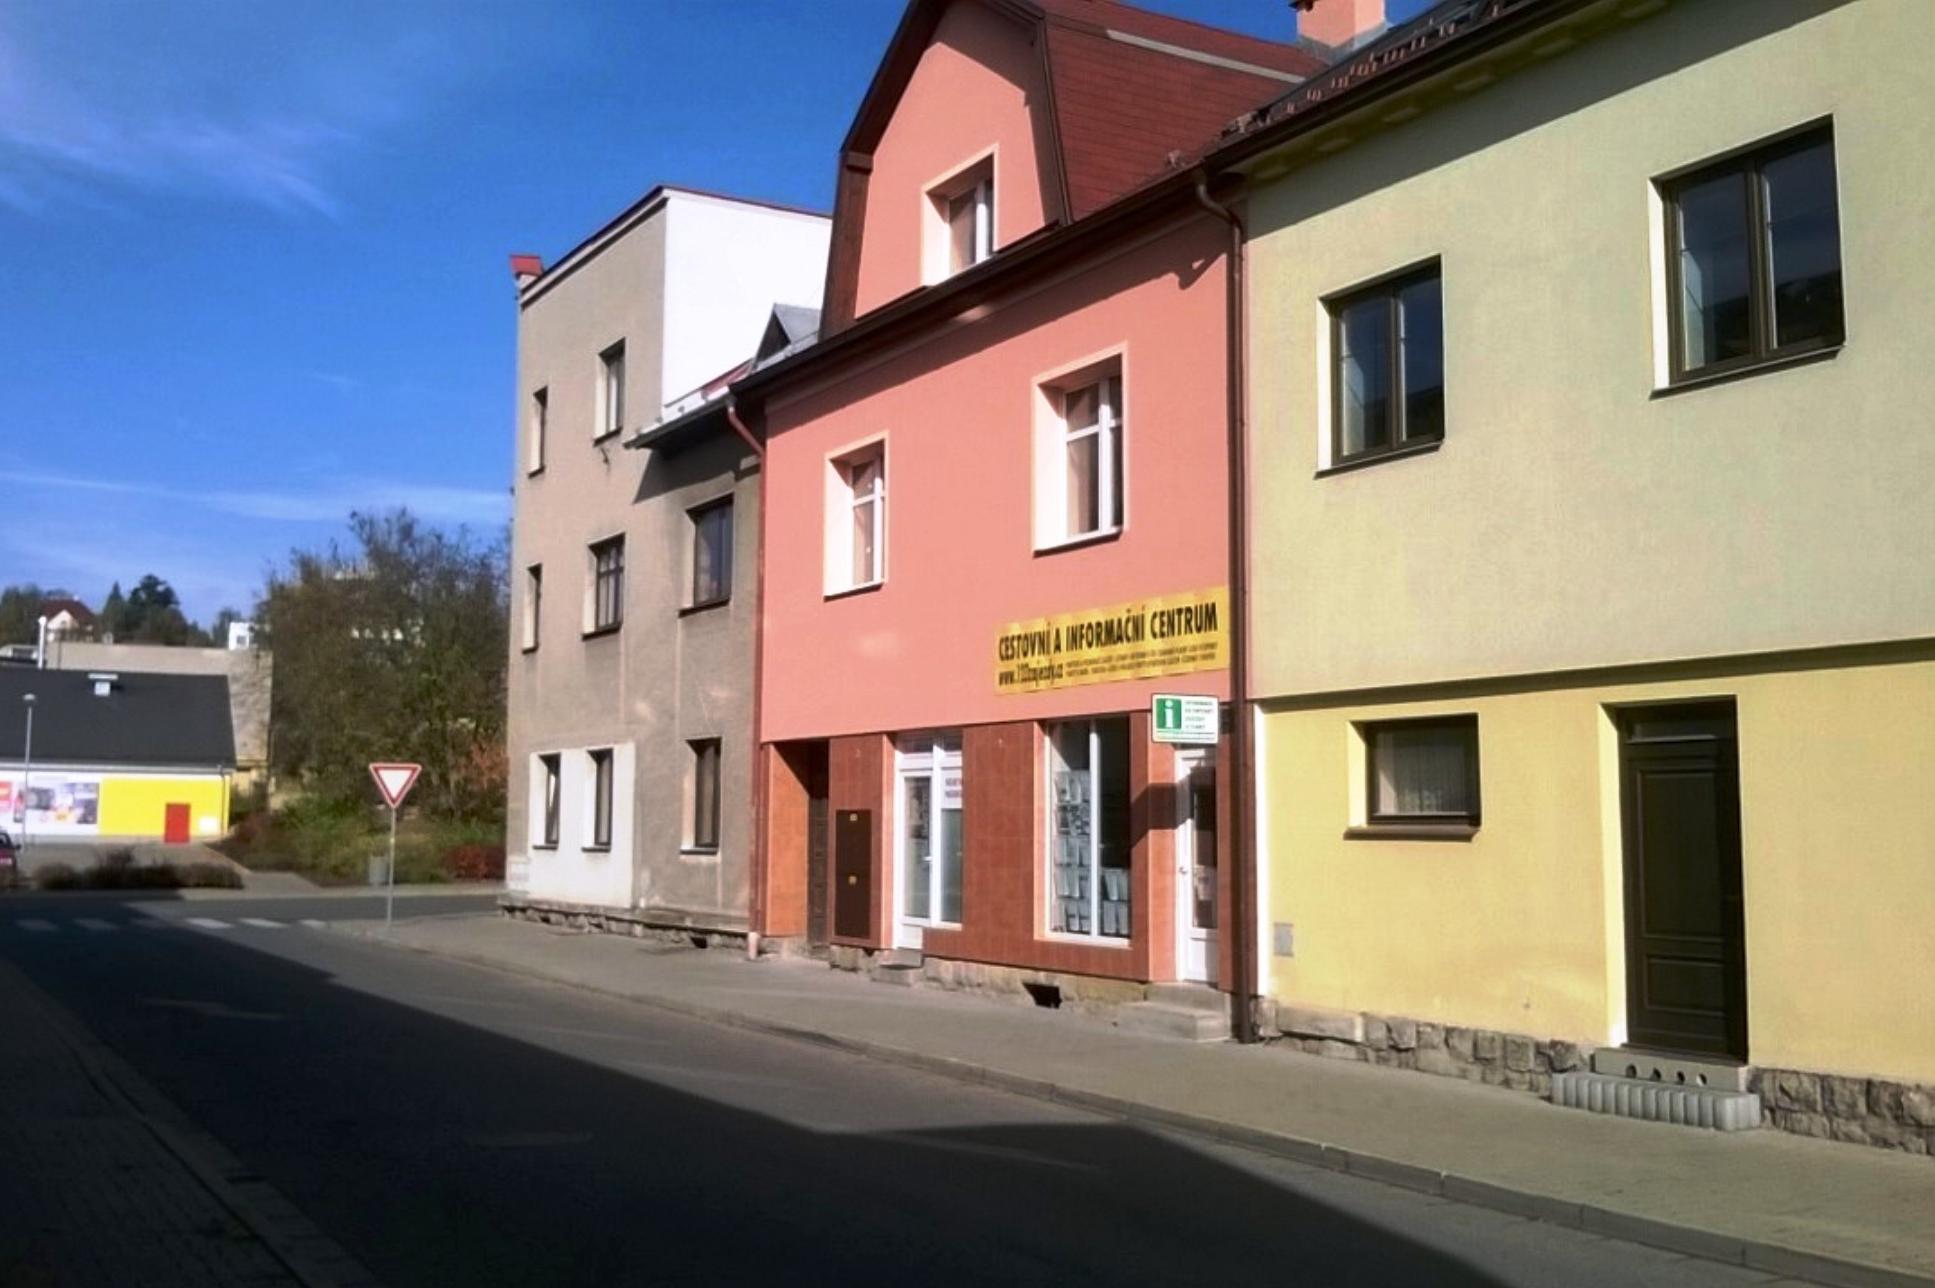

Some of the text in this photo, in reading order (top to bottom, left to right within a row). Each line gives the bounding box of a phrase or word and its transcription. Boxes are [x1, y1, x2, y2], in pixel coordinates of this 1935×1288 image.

[999, 621, 1051, 661] CESTOVNÍ
[1053, 627, 1061, 654] A
[1066, 605, 1145, 652] INFORMAČNÍ
[1150, 602, 1218, 639] CENTRUM
